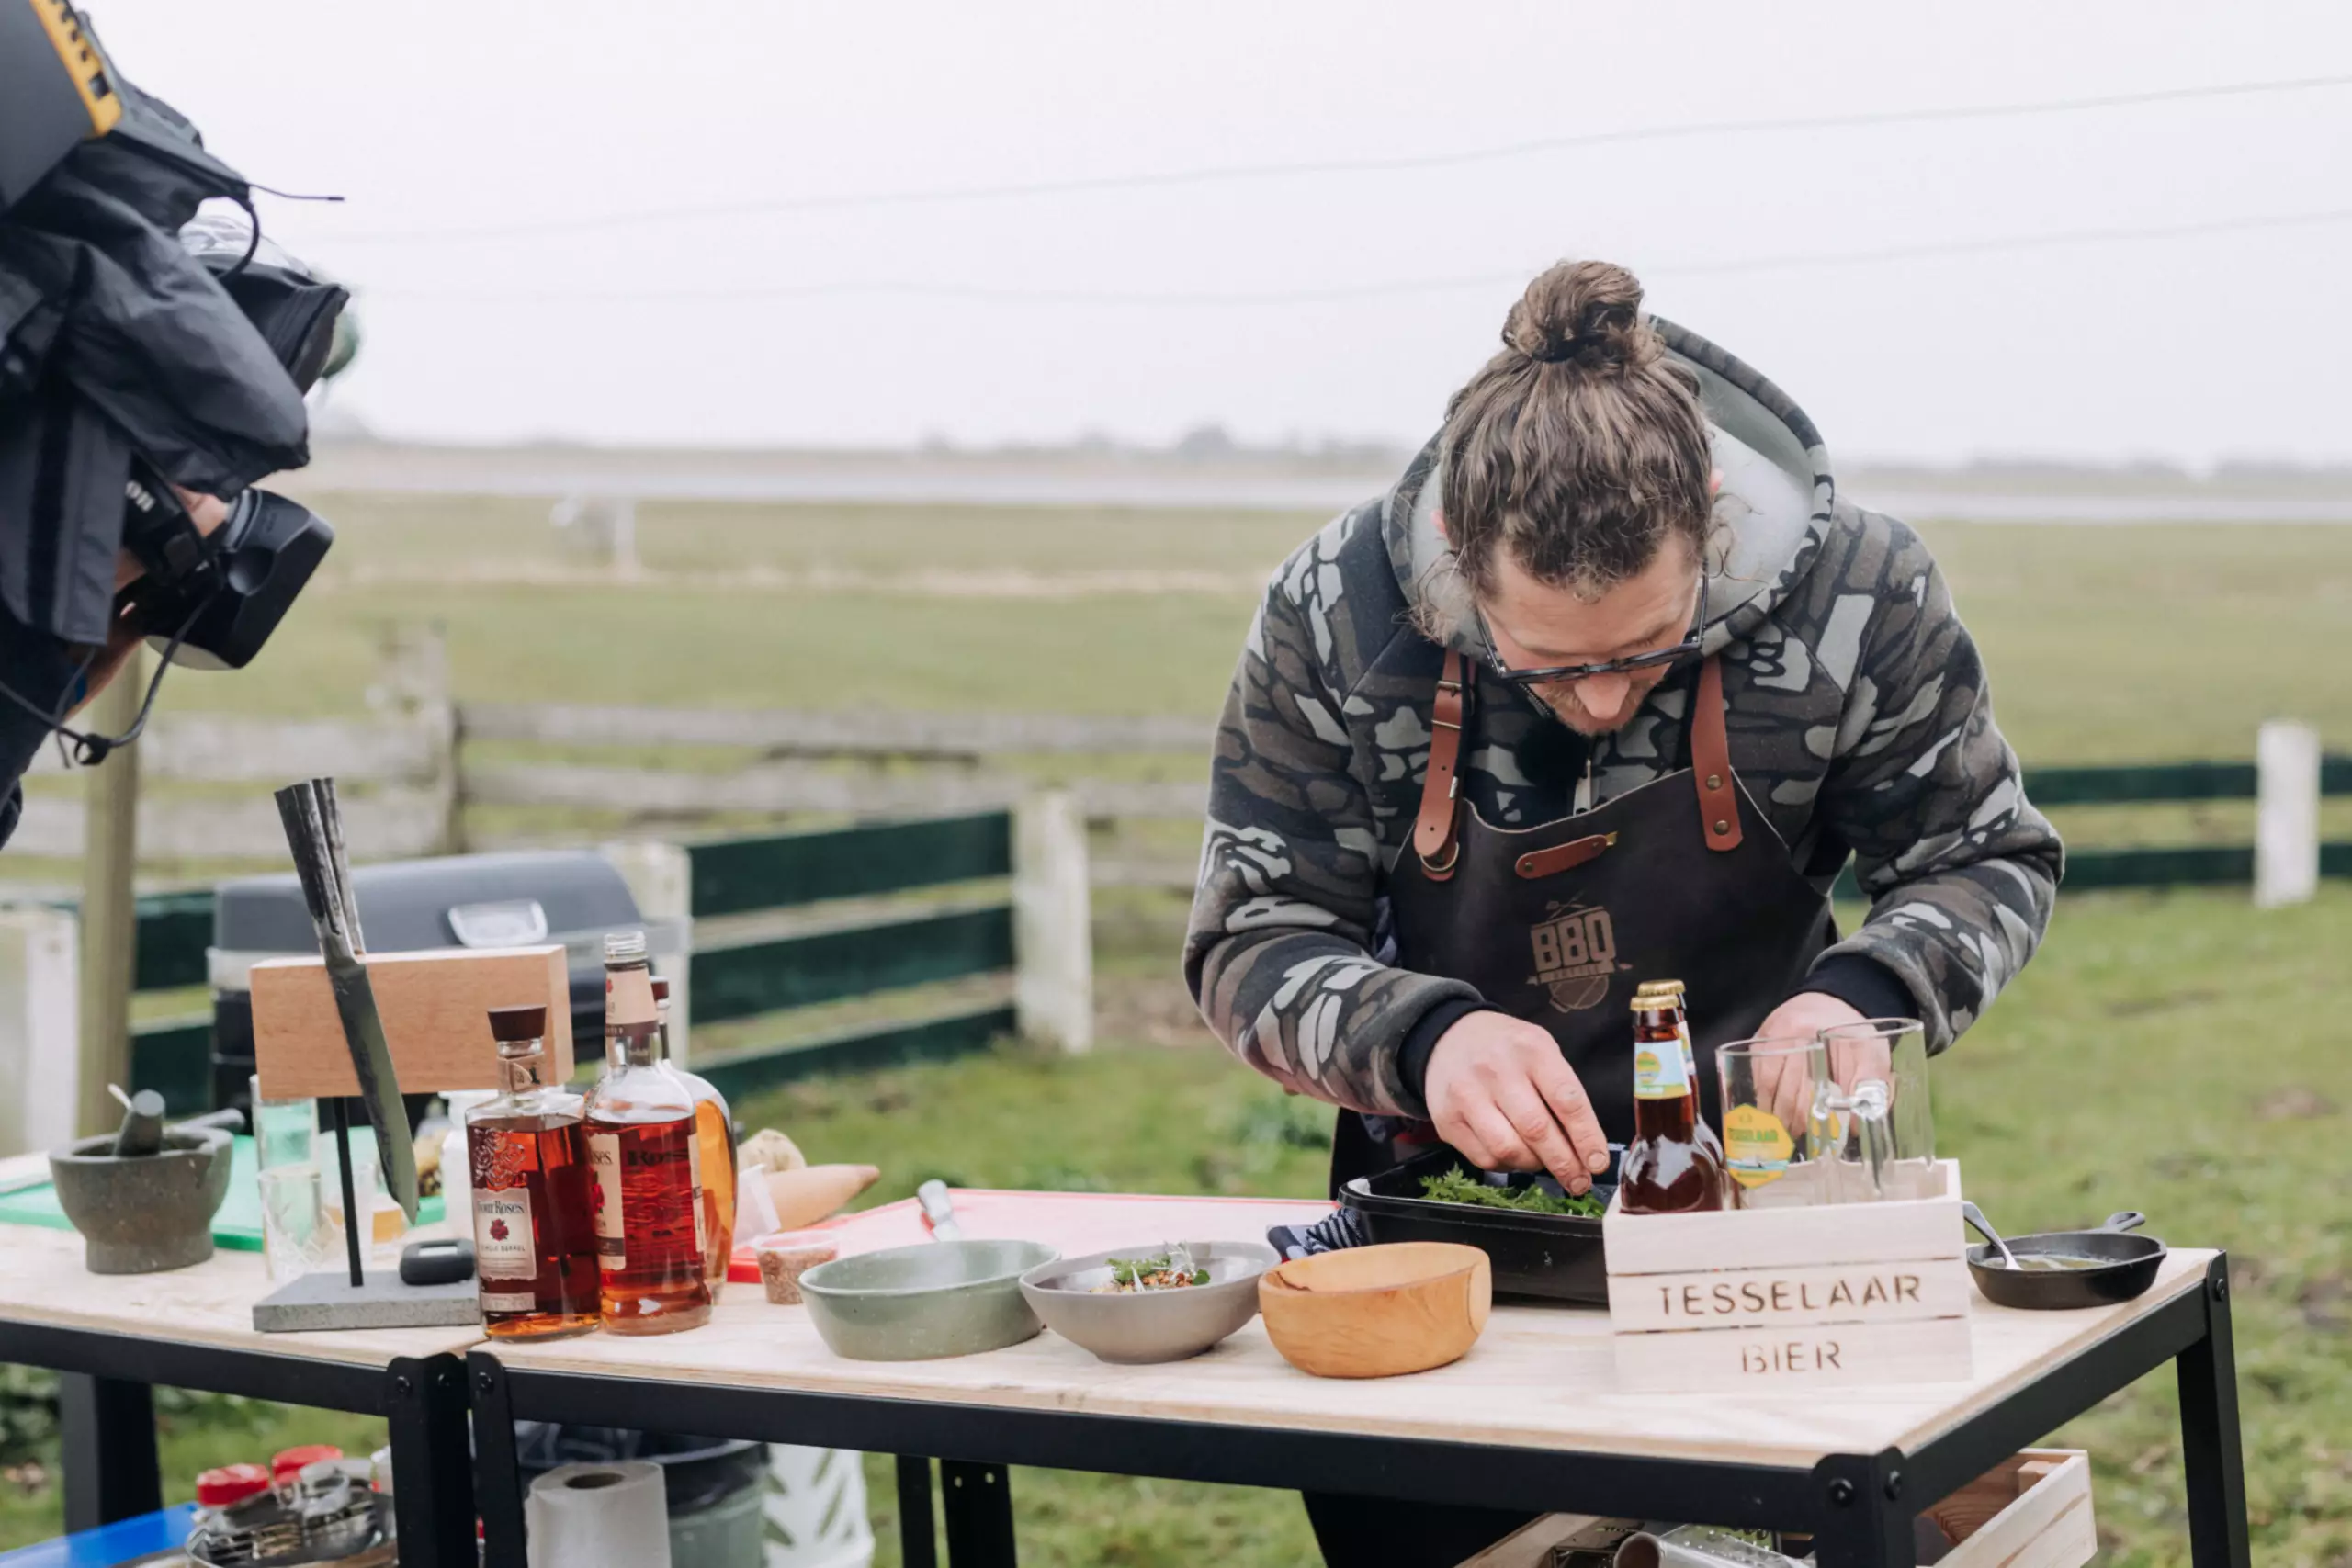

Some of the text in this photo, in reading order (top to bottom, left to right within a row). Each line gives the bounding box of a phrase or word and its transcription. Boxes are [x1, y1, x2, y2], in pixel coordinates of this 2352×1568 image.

[1531, 909, 1615, 973] BBQ
[494, 1200, 525, 1214] Roses
[1657, 1274, 1921, 1315] TESSELAAR
[1742, 1341, 1843, 1373] BIER
